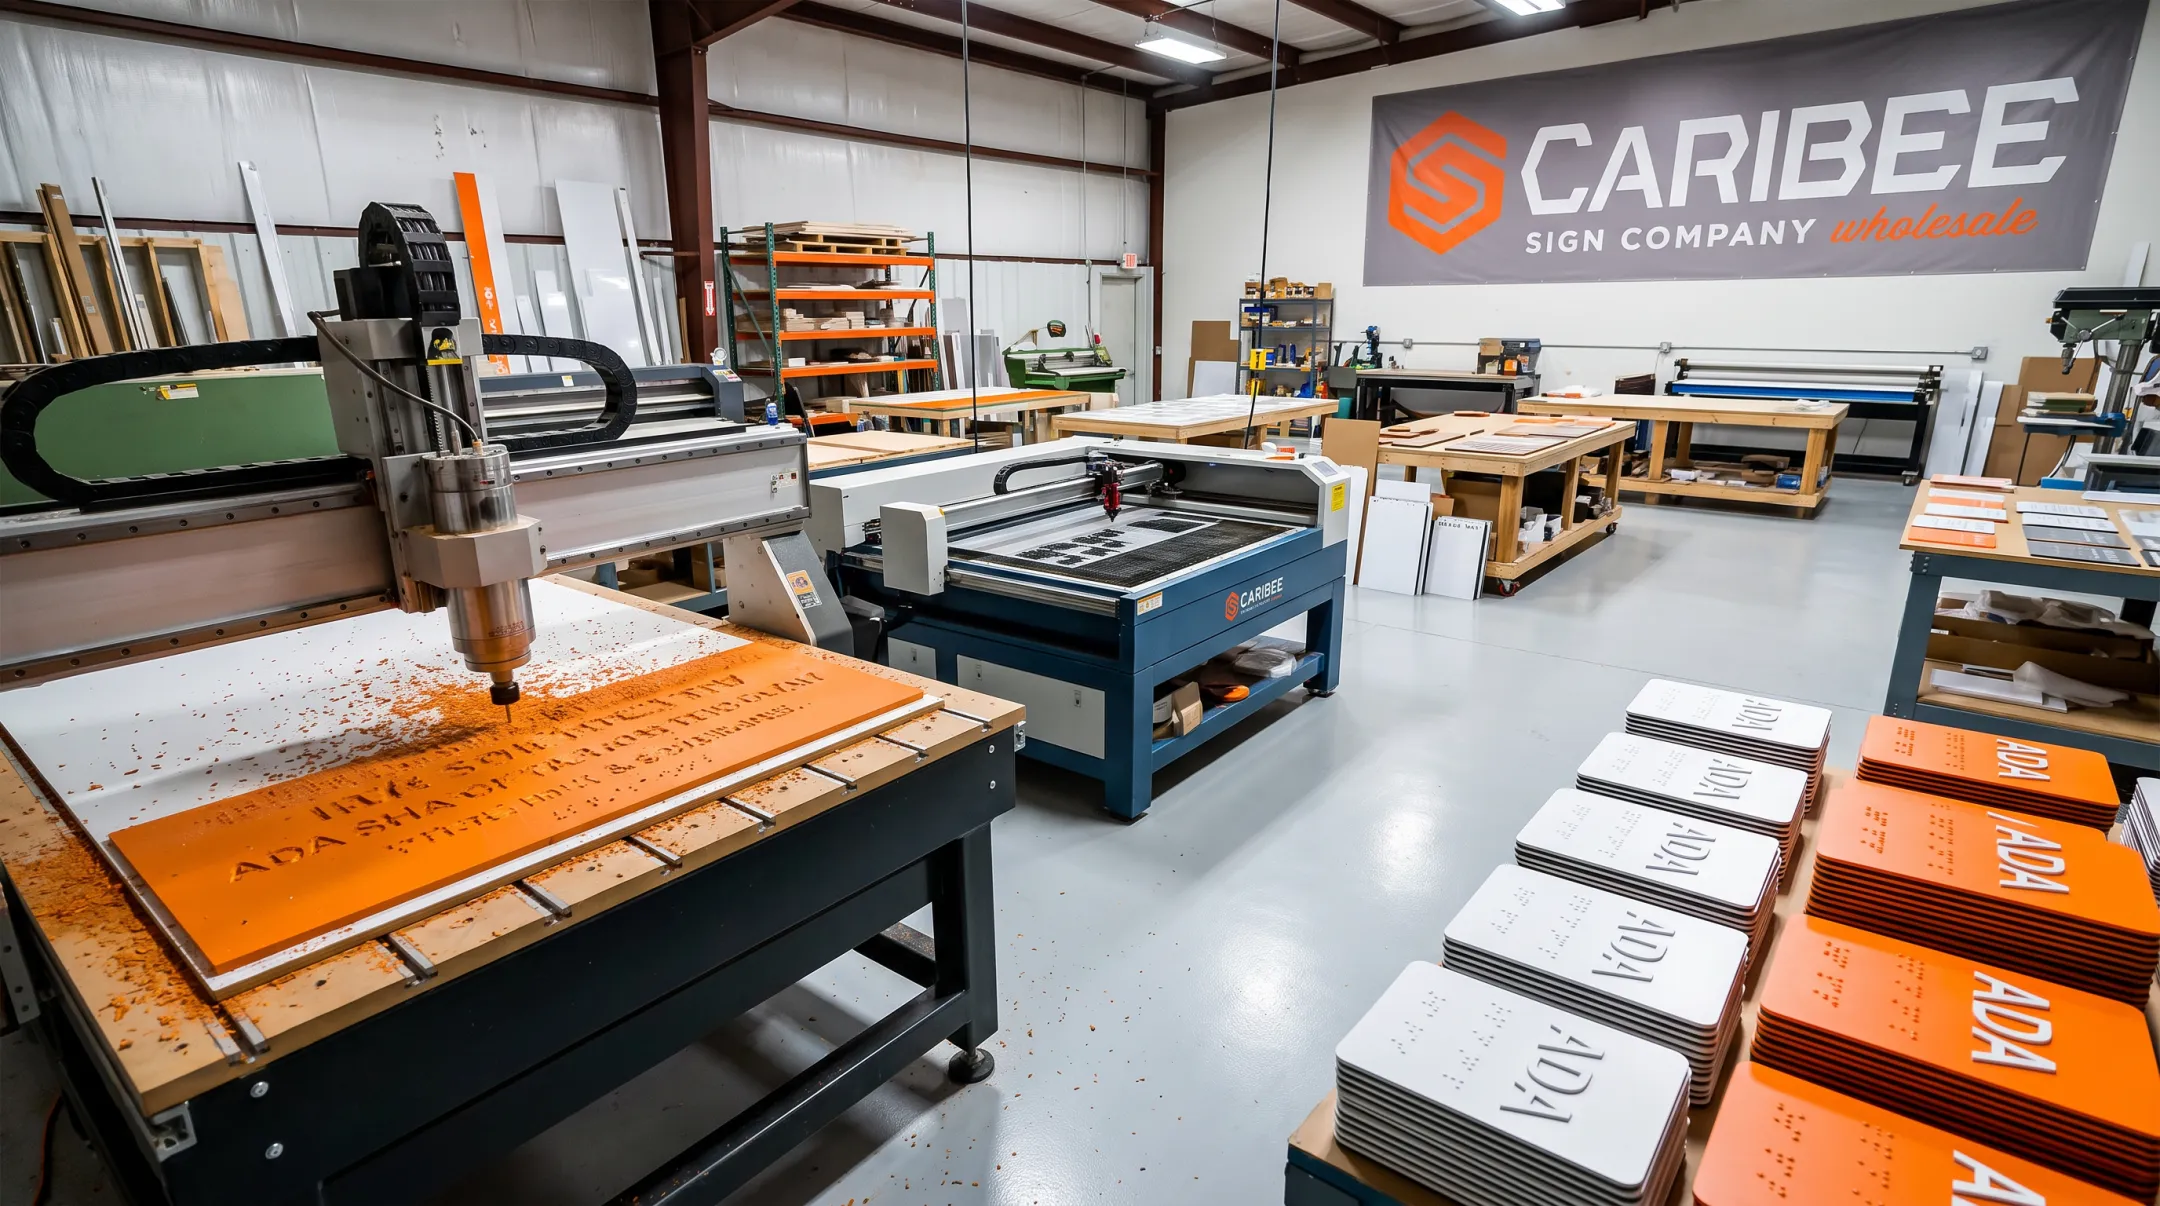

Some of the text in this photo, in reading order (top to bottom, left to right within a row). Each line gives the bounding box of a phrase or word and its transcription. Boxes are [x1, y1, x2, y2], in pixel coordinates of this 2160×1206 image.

[1521, 76, 2080, 216] CARIBEE
[1525, 197, 2040, 254] SIGN COMPANY wholesale
[1240, 576, 1284, 609] CARIBEE
[1731, 698, 1782, 731] ADA
[1693, 758, 1753, 800] ADA
[1996, 738, 2051, 781] ADA
[229, 835, 347, 883] ADA
[1644, 822, 1717, 876] ADA
[1591, 910, 1676, 983] ADA
[1971, 970, 2057, 1074] ADA
[1499, 1024, 1606, 1124] ADA
